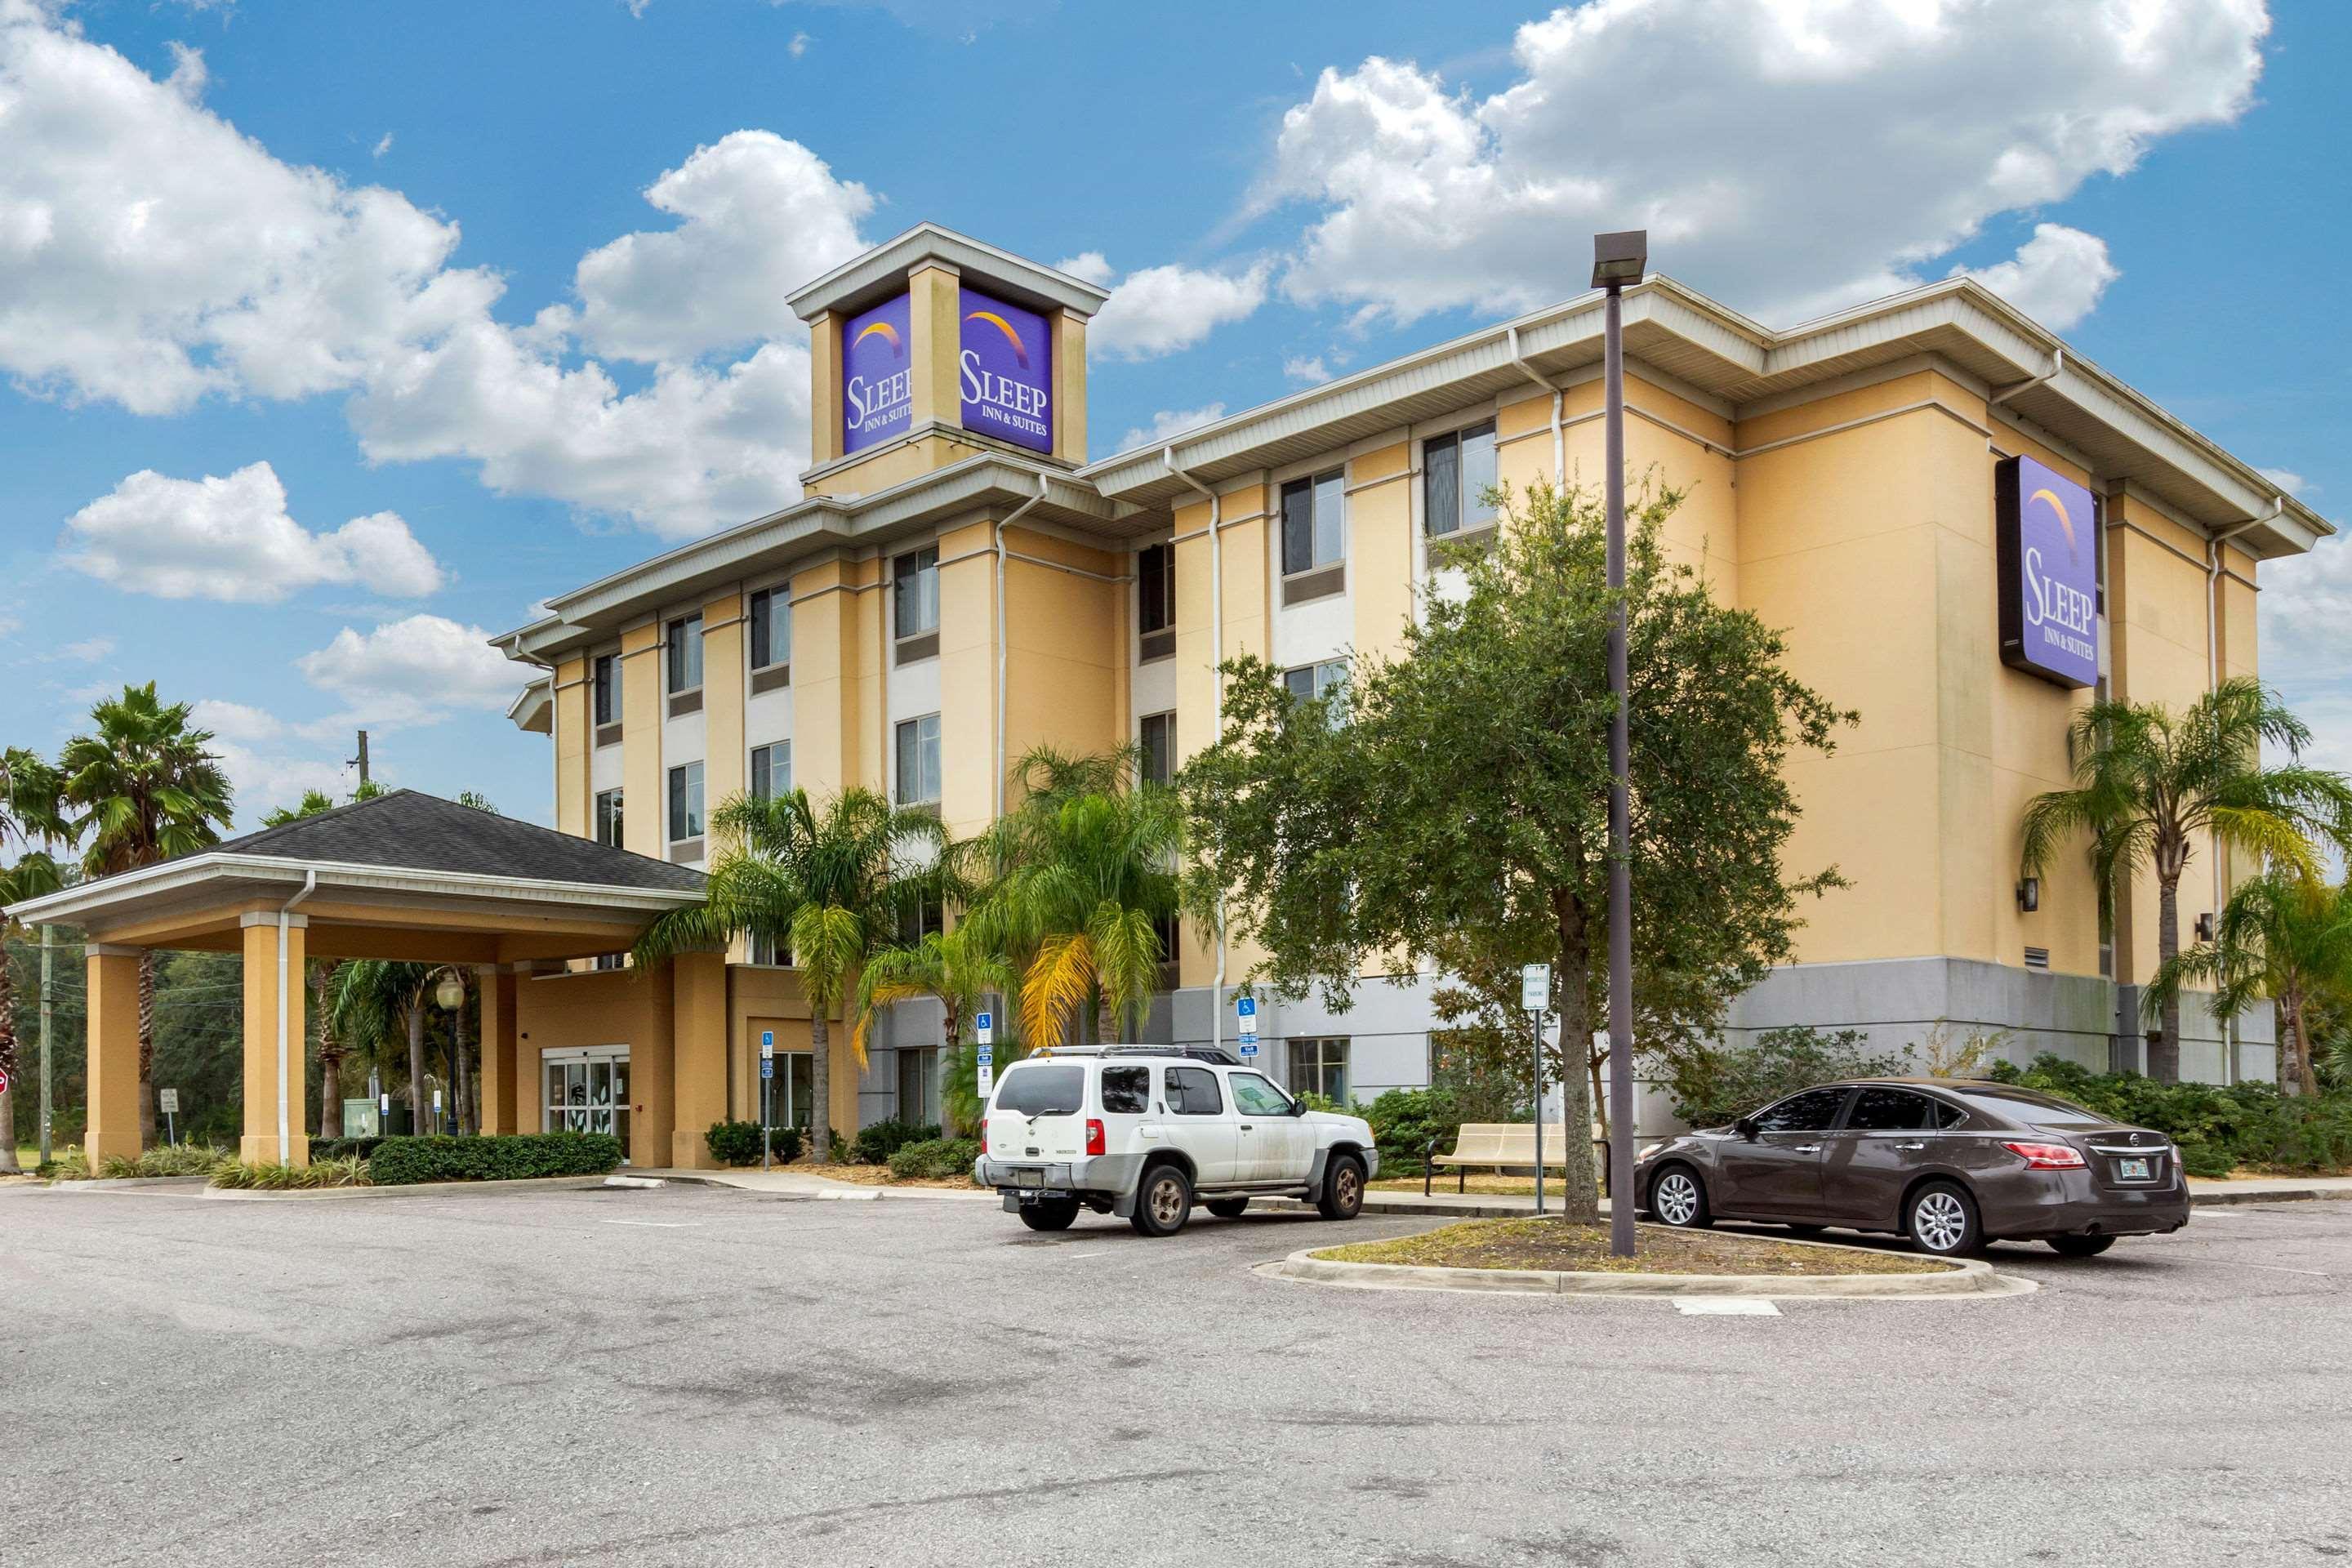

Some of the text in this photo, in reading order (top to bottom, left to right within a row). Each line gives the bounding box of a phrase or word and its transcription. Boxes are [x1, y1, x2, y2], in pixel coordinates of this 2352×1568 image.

[960, 350, 1047, 418] SLEEP
[865, 415, 880, 433] INN
[881, 414, 888, 425] &
[982, 405, 1047, 436] INN & SUITES
[2025, 546, 2093, 635] SLEEP
[2044, 626, 2094, 662] INN & SUITES
